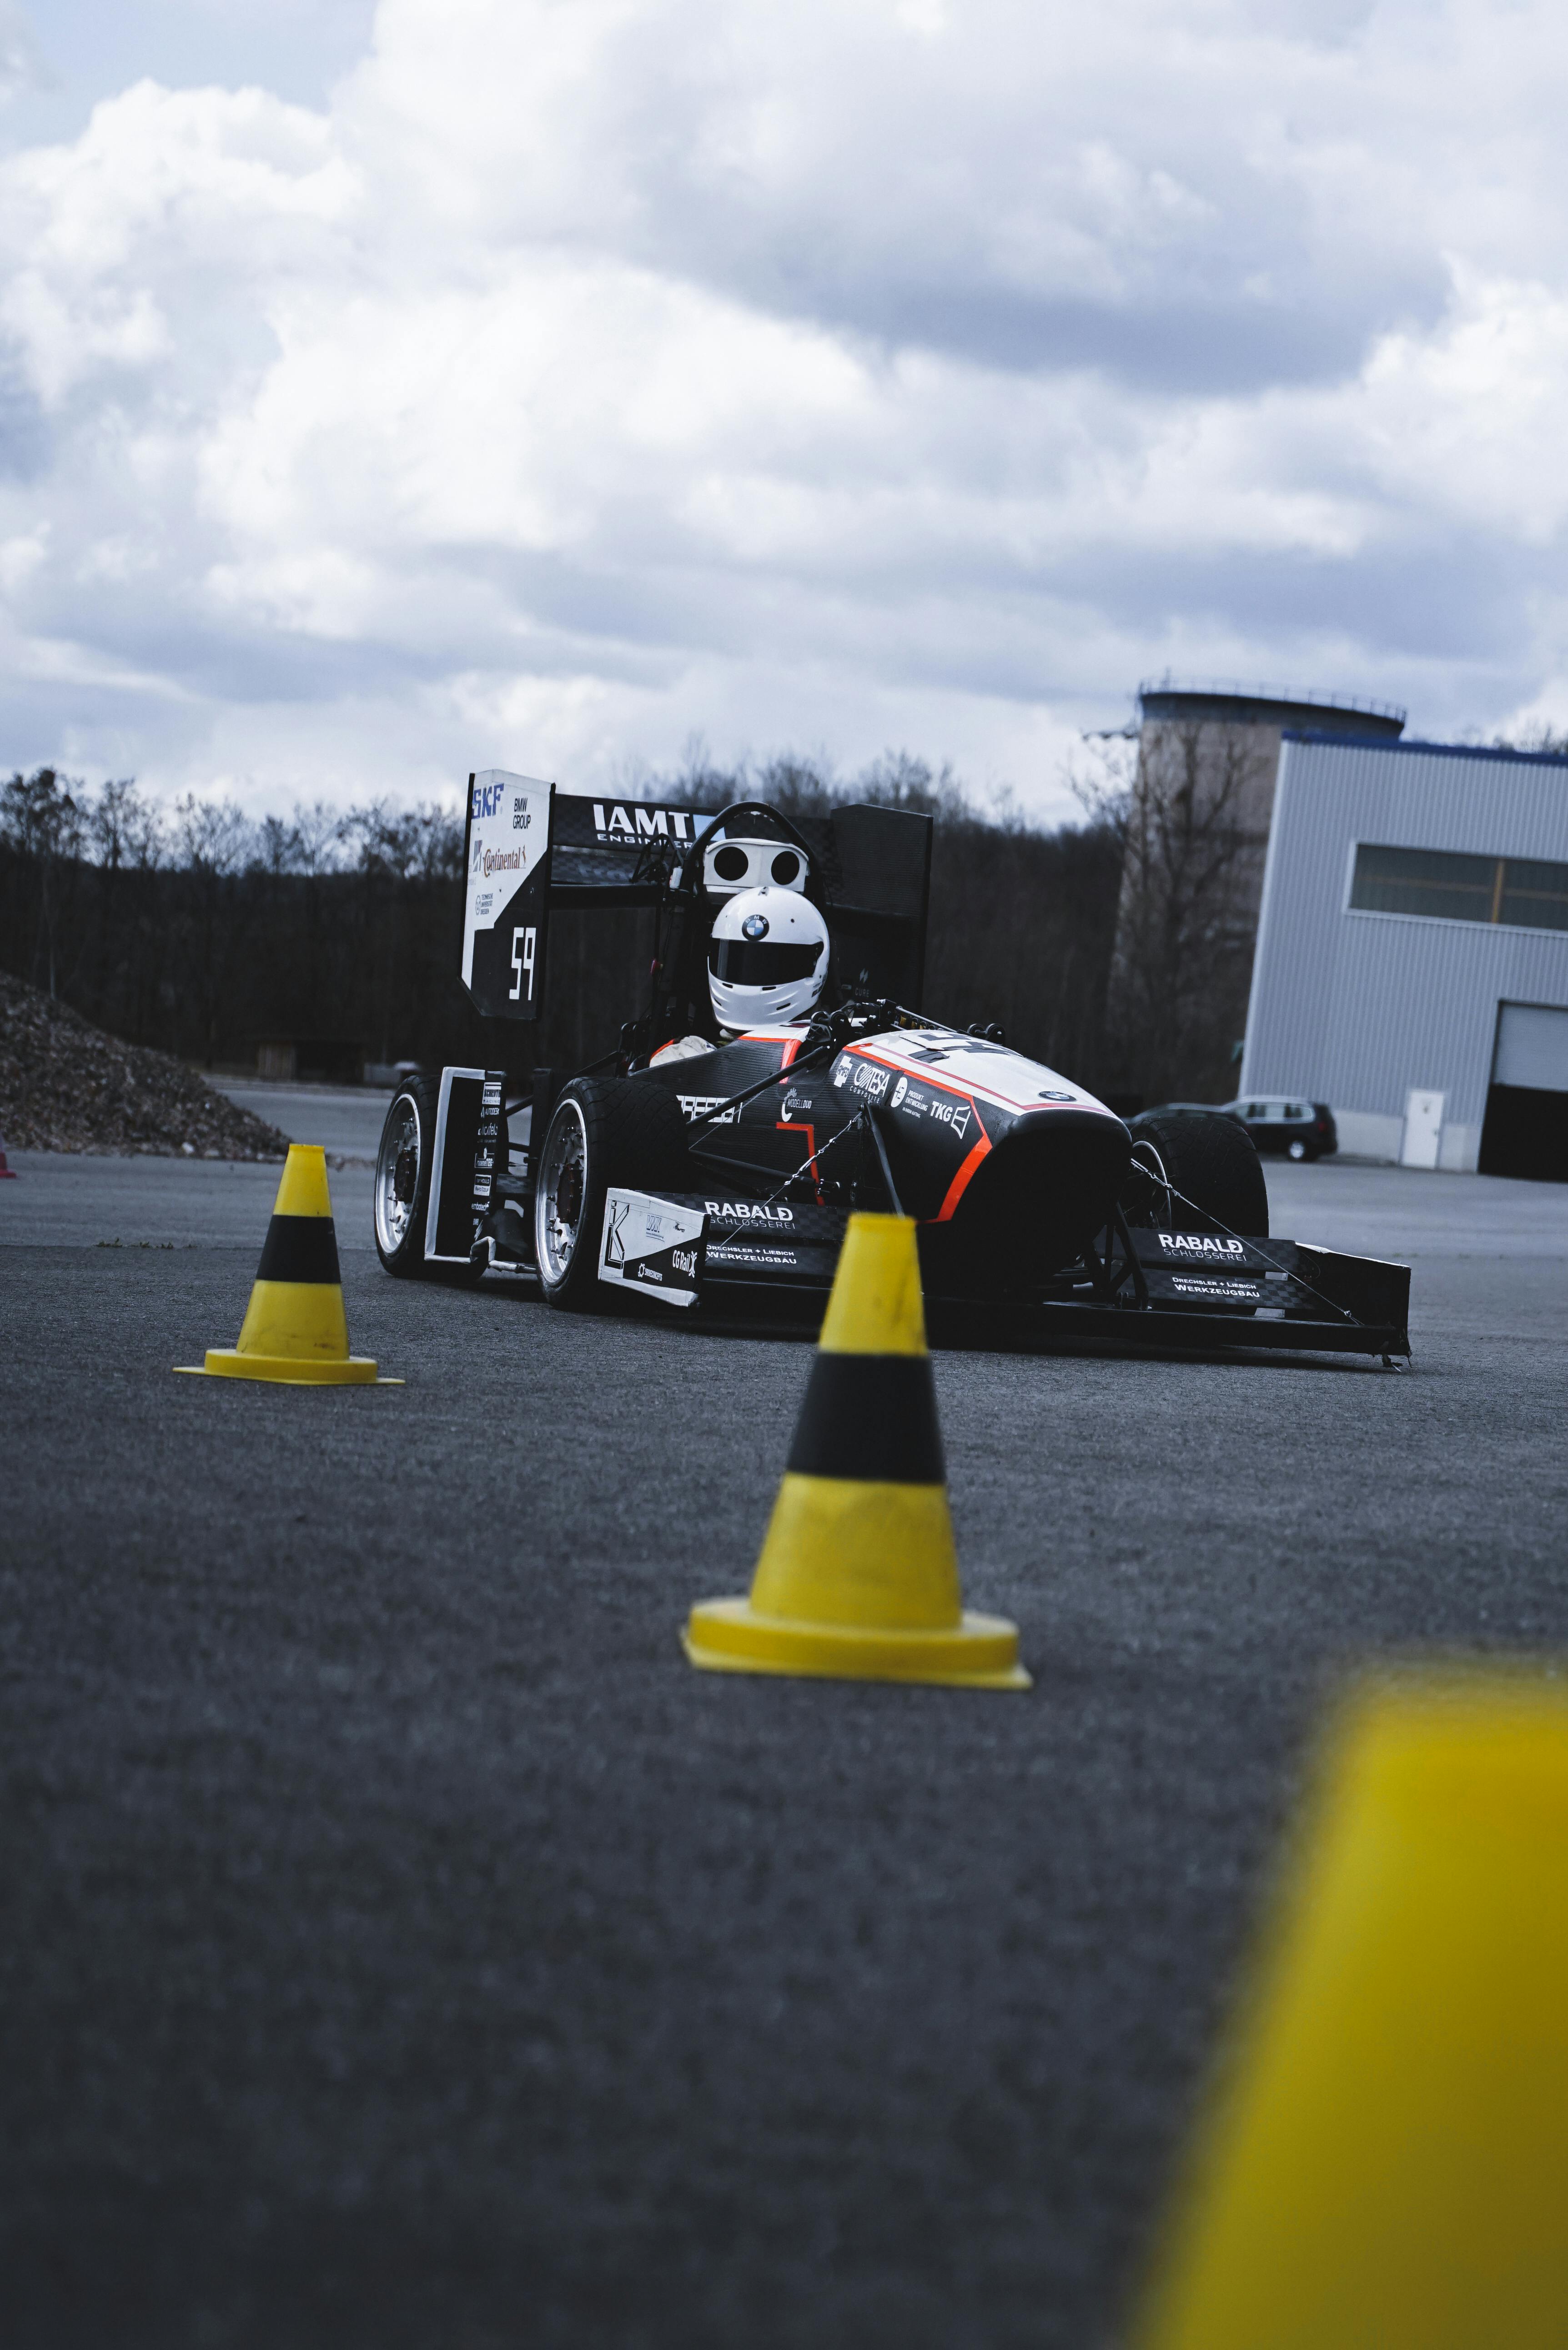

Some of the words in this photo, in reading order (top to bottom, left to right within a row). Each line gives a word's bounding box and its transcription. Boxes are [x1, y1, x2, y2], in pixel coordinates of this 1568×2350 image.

[472, 783, 504, 819] SKF
[514, 798, 528, 812] BMW
[513, 814, 531, 829] GROUP
[593, 804, 689, 839] IAMT
[483, 847, 521, 878] Continental
[745, 915, 768, 924] BMW
[509, 927, 536, 1000] 59
[854, 987, 870, 997] CURE
[849, 1085, 880, 1104] COMPOSITE
[930, 1100, 953, 1122] TKG
[704, 1201, 793, 1221] RABALD
[710, 1216, 795, 1229] SCHLOSSEREI
[1158, 1234, 1243, 1253] RABALD
[1164, 1249, 1247, 1261] SCHLOSSEREI
